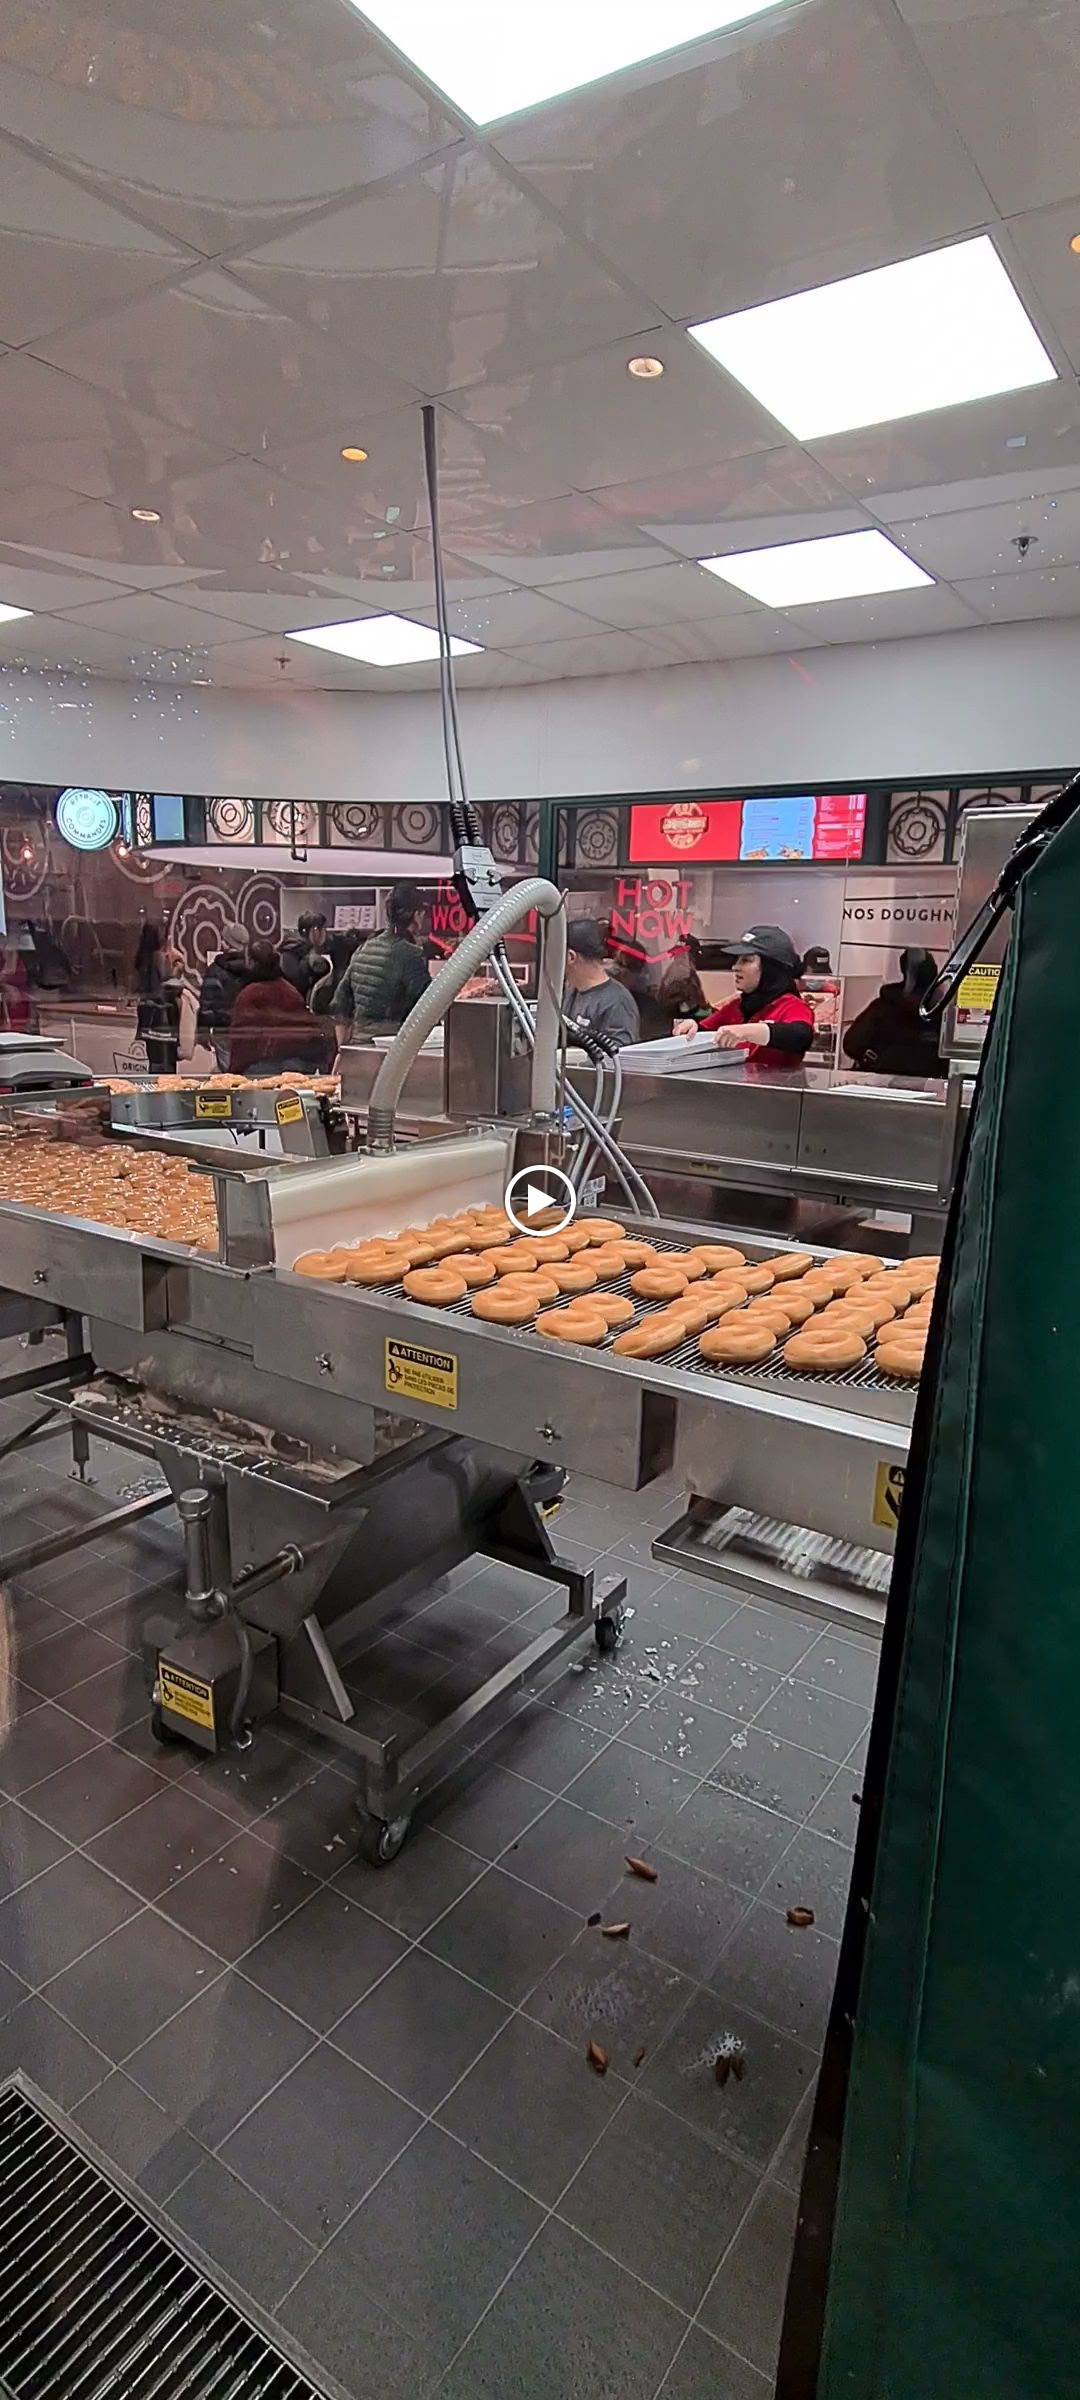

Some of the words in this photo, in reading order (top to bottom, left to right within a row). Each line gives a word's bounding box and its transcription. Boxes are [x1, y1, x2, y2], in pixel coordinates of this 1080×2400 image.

[66, 817, 106, 839] COMMANDES
[617, 879, 694, 909] HOT
[610, 909, 694, 940] NOW
[842, 908, 875, 921] NOS
[881, 908, 955, 921] DOUGHN
[968, 967, 1001, 976] CAUTIO
[122, 1062, 148, 1072] ORIGIN
[400, 1347, 451, 1370] ATTENTION
